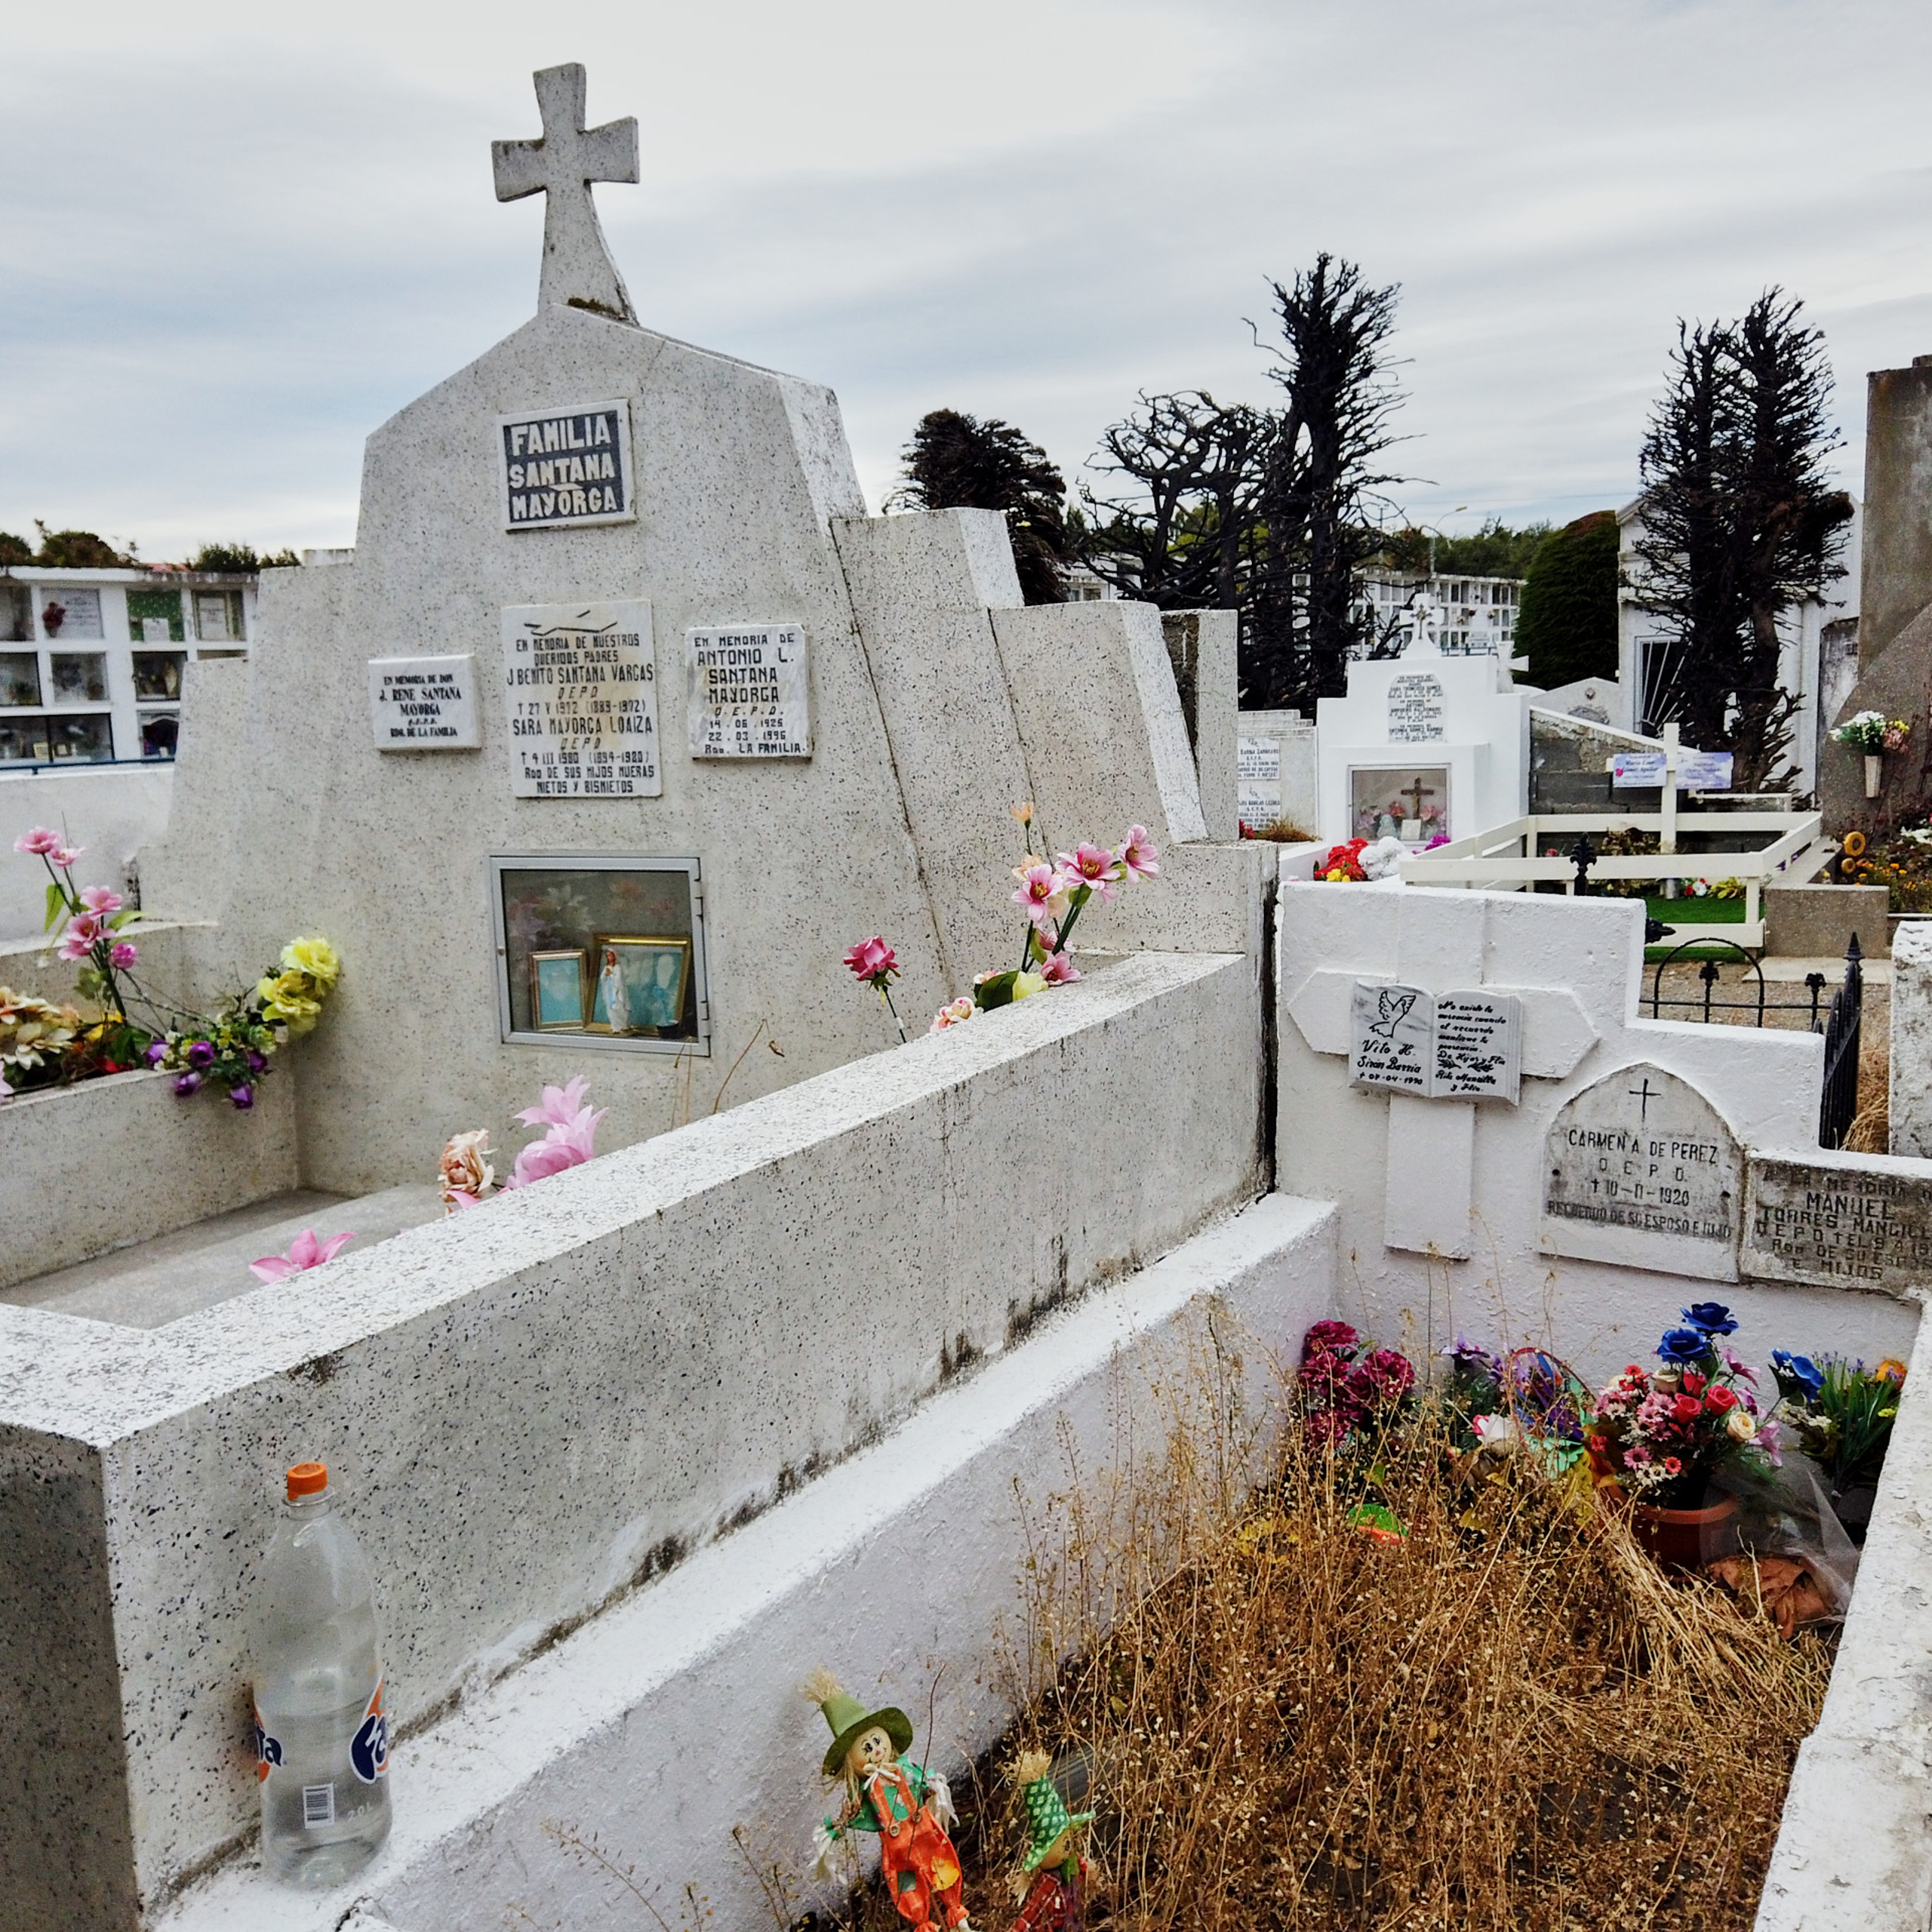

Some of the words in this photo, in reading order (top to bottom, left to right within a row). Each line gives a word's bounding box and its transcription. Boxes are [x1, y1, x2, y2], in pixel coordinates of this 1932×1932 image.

[510, 414, 611, 456] FAMILIA
[509, 453, 615, 488] SANTANA
[512, 486, 617, 520] MAYORGA
[534, 636, 569, 651] MEMORIA
[576, 636, 586, 649] DE
[593, 633, 639, 648] NUESTROS
[719, 635, 768, 646] MEMORIA
[780, 633, 795, 643] DE
[534, 652, 578, 666] QUERIDOS
[584, 650, 618, 663] PADRES
[697, 648, 761, 666] ANTONIO
[383, 676, 392, 685] EN
[395, 675, 426, 685] MEMORIA
[428, 675, 437, 683] DE
[517, 667, 553, 685] BENITO
[558, 666, 605, 684] SANTANA
[611, 663, 653, 682] VARGAS
[709, 667, 777, 685] SANTANA
[421, 687, 461, 700] SANTANA
[709, 687, 779, 703] MAYORGA
[400, 703, 441, 716] MAYORGA
[418, 728, 427, 737] LA
[430, 727, 457, 736] FAMILIA
[513, 718, 542, 736] SARA
[549, 717, 601, 734] MAYORGA
[610, 715, 652, 734] LOAIZA
[739, 743, 752, 753] LA
[547, 767, 558, 778] DE
[565, 767, 581, 778] SUS
[586, 766, 613, 778] HIJOS
[537, 781, 567, 793] NIETOS
[585, 780, 633, 793] BISNIETOS
[1452, 1026, 1494, 1034] recuerdo
[1362, 1039, 1391, 1054] Vito
[1569, 1130, 1626, 1152] CARMEN
[1650, 1140, 1666, 1158] DE
[1671, 1142, 1718, 1164] PEREZ
[1807, 1192, 1894, 1220] MANUEL
[1644, 1214, 1690, 1232] ESPOSO
[1762, 1205, 1838, 1229] TORRES
[1817, 1244, 1837, 1258] DE
